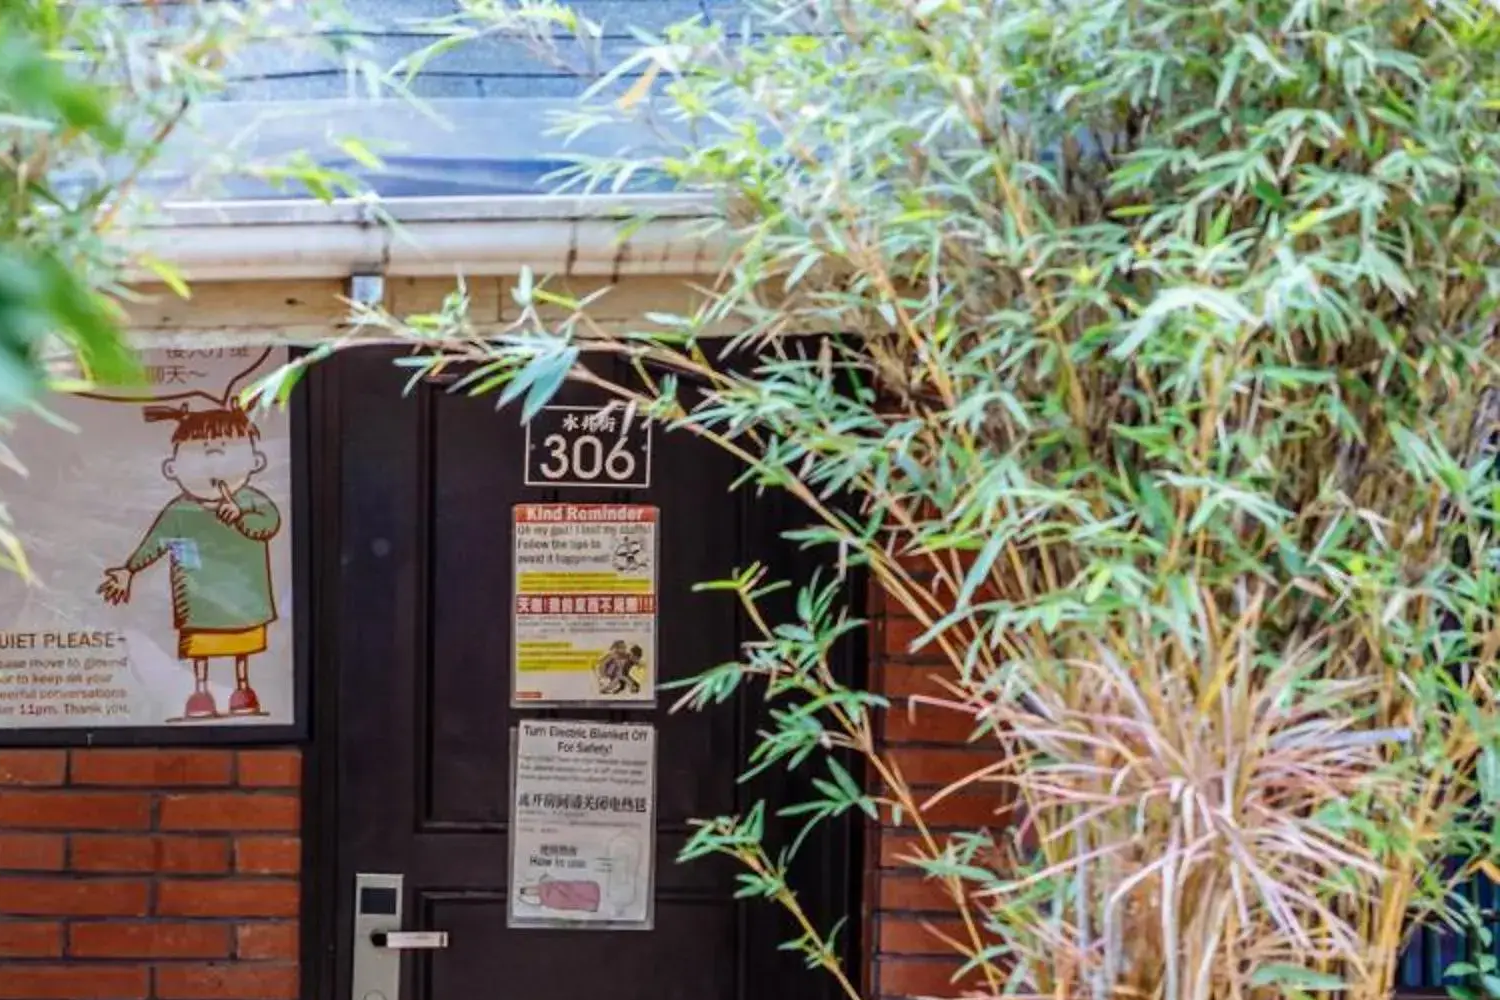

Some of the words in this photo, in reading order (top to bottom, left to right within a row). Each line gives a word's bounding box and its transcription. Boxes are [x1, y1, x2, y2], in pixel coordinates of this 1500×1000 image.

[539, 434, 636, 480] 306
[527, 506, 563, 521] Kind
[566, 506, 645, 521] Reminder
[517, 540, 549, 549] Follow
[551, 540, 568, 549] the
[590, 540, 602, 549] to
[29, 658, 64, 669] move
[68, 656, 81, 668] to
[84, 657, 129, 671] ground
[16, 673, 29, 684] to
[32, 671, 63, 686] keep
[86, 673, 113, 686] your
[40, 688, 127, 701] conversations
[19, 703, 59, 717] 11pm.
[64, 703, 102, 715] Thank
[524, 725, 546, 737] Turn
[550, 726, 587, 739] Electric
[590, 728, 629, 740] Blanket
[631, 730, 648, 741] Off
[557, 741, 574, 752] For
[576, 743, 613, 756] Safety!
[530, 856, 553, 867] How
[555, 858, 566, 867] to
